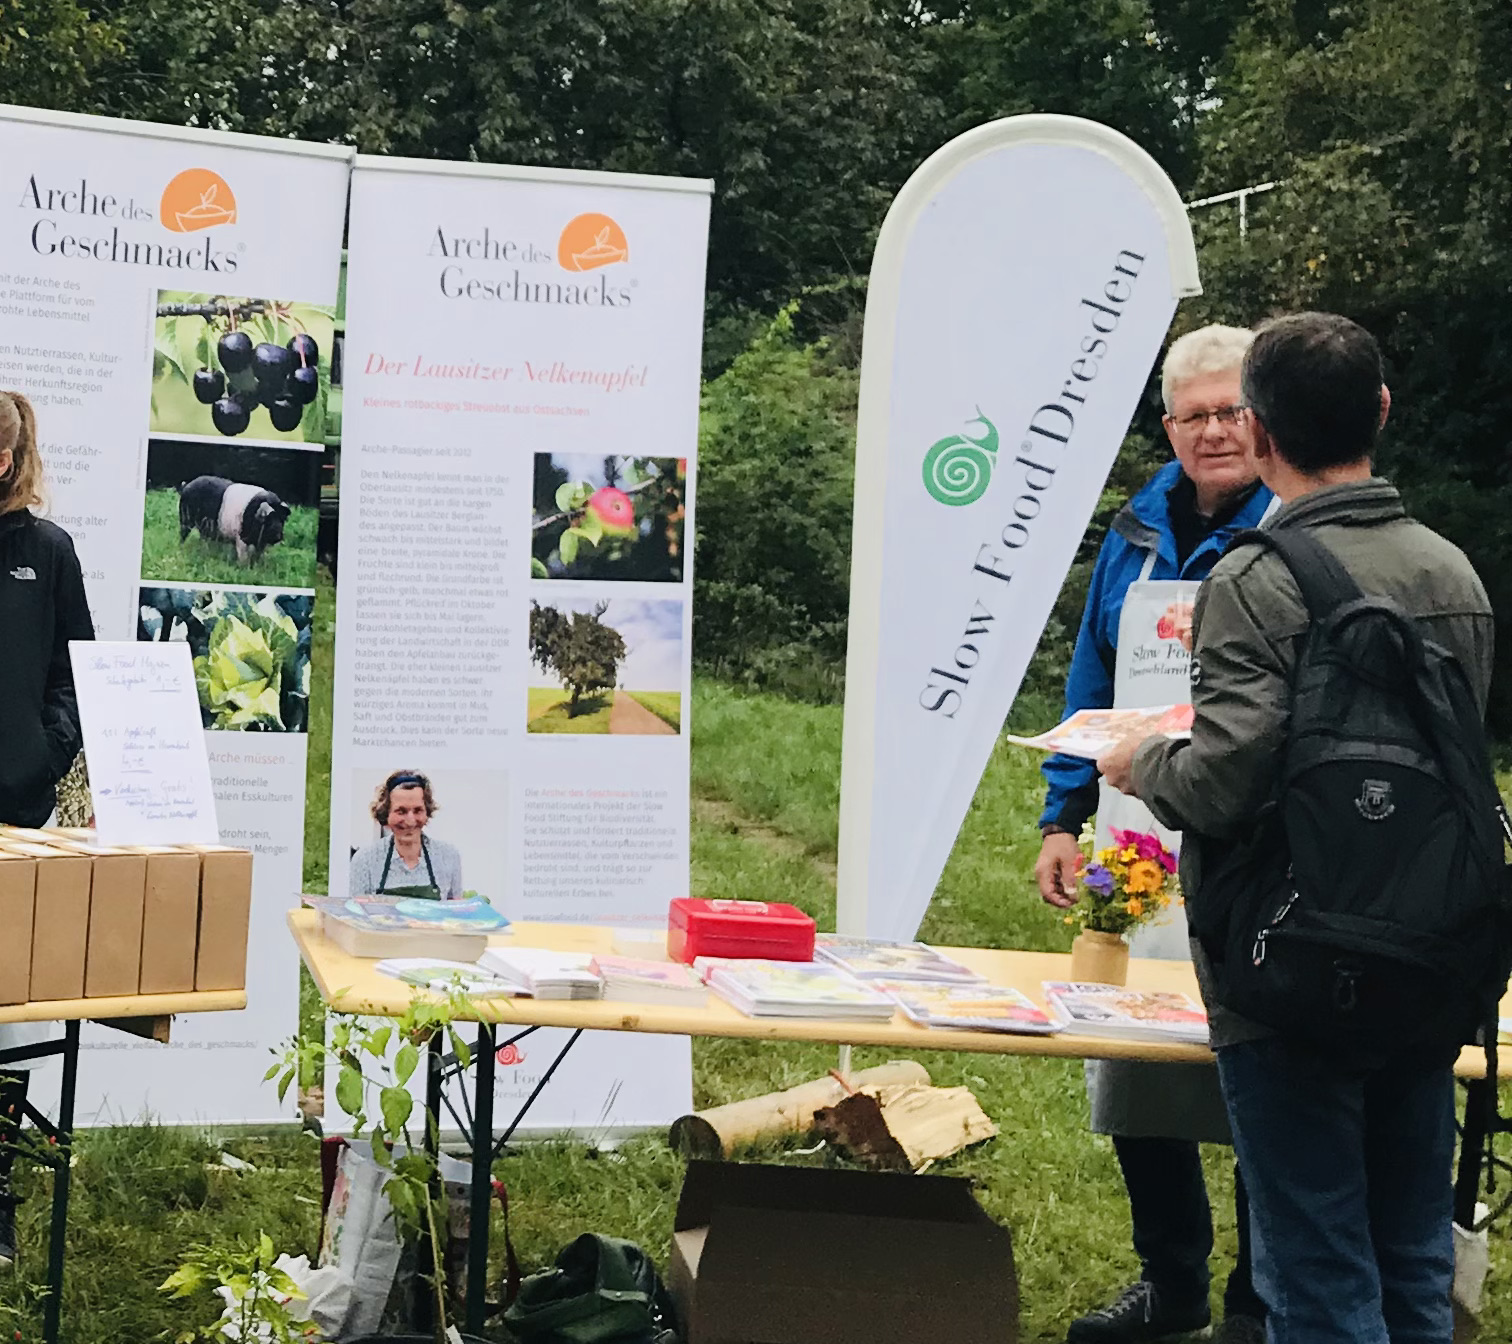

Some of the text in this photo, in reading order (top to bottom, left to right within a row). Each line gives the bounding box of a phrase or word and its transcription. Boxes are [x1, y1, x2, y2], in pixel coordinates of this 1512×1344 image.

[19, 173, 153, 222] Arche des
[427, 224, 552, 265] Arche des
[13, 272, 31, 286] der
[32, 274, 61, 289] Arche
[63, 277, 81, 291] des
[8, 286, 55, 303] Plattform
[57, 291, 72, 304] für
[73, 295, 95, 306] vom
[26, 304, 90, 322] Lebensmittel
[12, 342, 86, 363] Nutztierrassen,
[87, 348, 122, 363] Kultur-
[24, 360, 65, 377] werden,
[66, 362, 82, 375] die
[84, 363, 94, 376] in
[96, 364, 113, 378] der
[364, 352, 648, 393] Der Lausitzer Nelkenapfel
[24, 374, 103, 394] Herkunftsregion
[50, 391, 83, 406] haben.
[363, 395, 401, 409] Kleines
[47, 443, 63, 455] die
[65, 444, 103, 458] Gefähr-
[52, 459, 72, 471] und
[74, 460, 90, 472] die
[918, 597, 998, 721] Slow
[1028, 247, 1148, 450] Dresden
[84, 515, 108, 528] alter
[90, 570, 105, 581] als
[1132, 643, 1161, 662] Slow
[208, 751, 286, 765] Arche müssen
[241, 791, 294, 803] Esskulturen
[248, 828, 272, 840] sein,
[253, 844, 289, 857] Mengen
